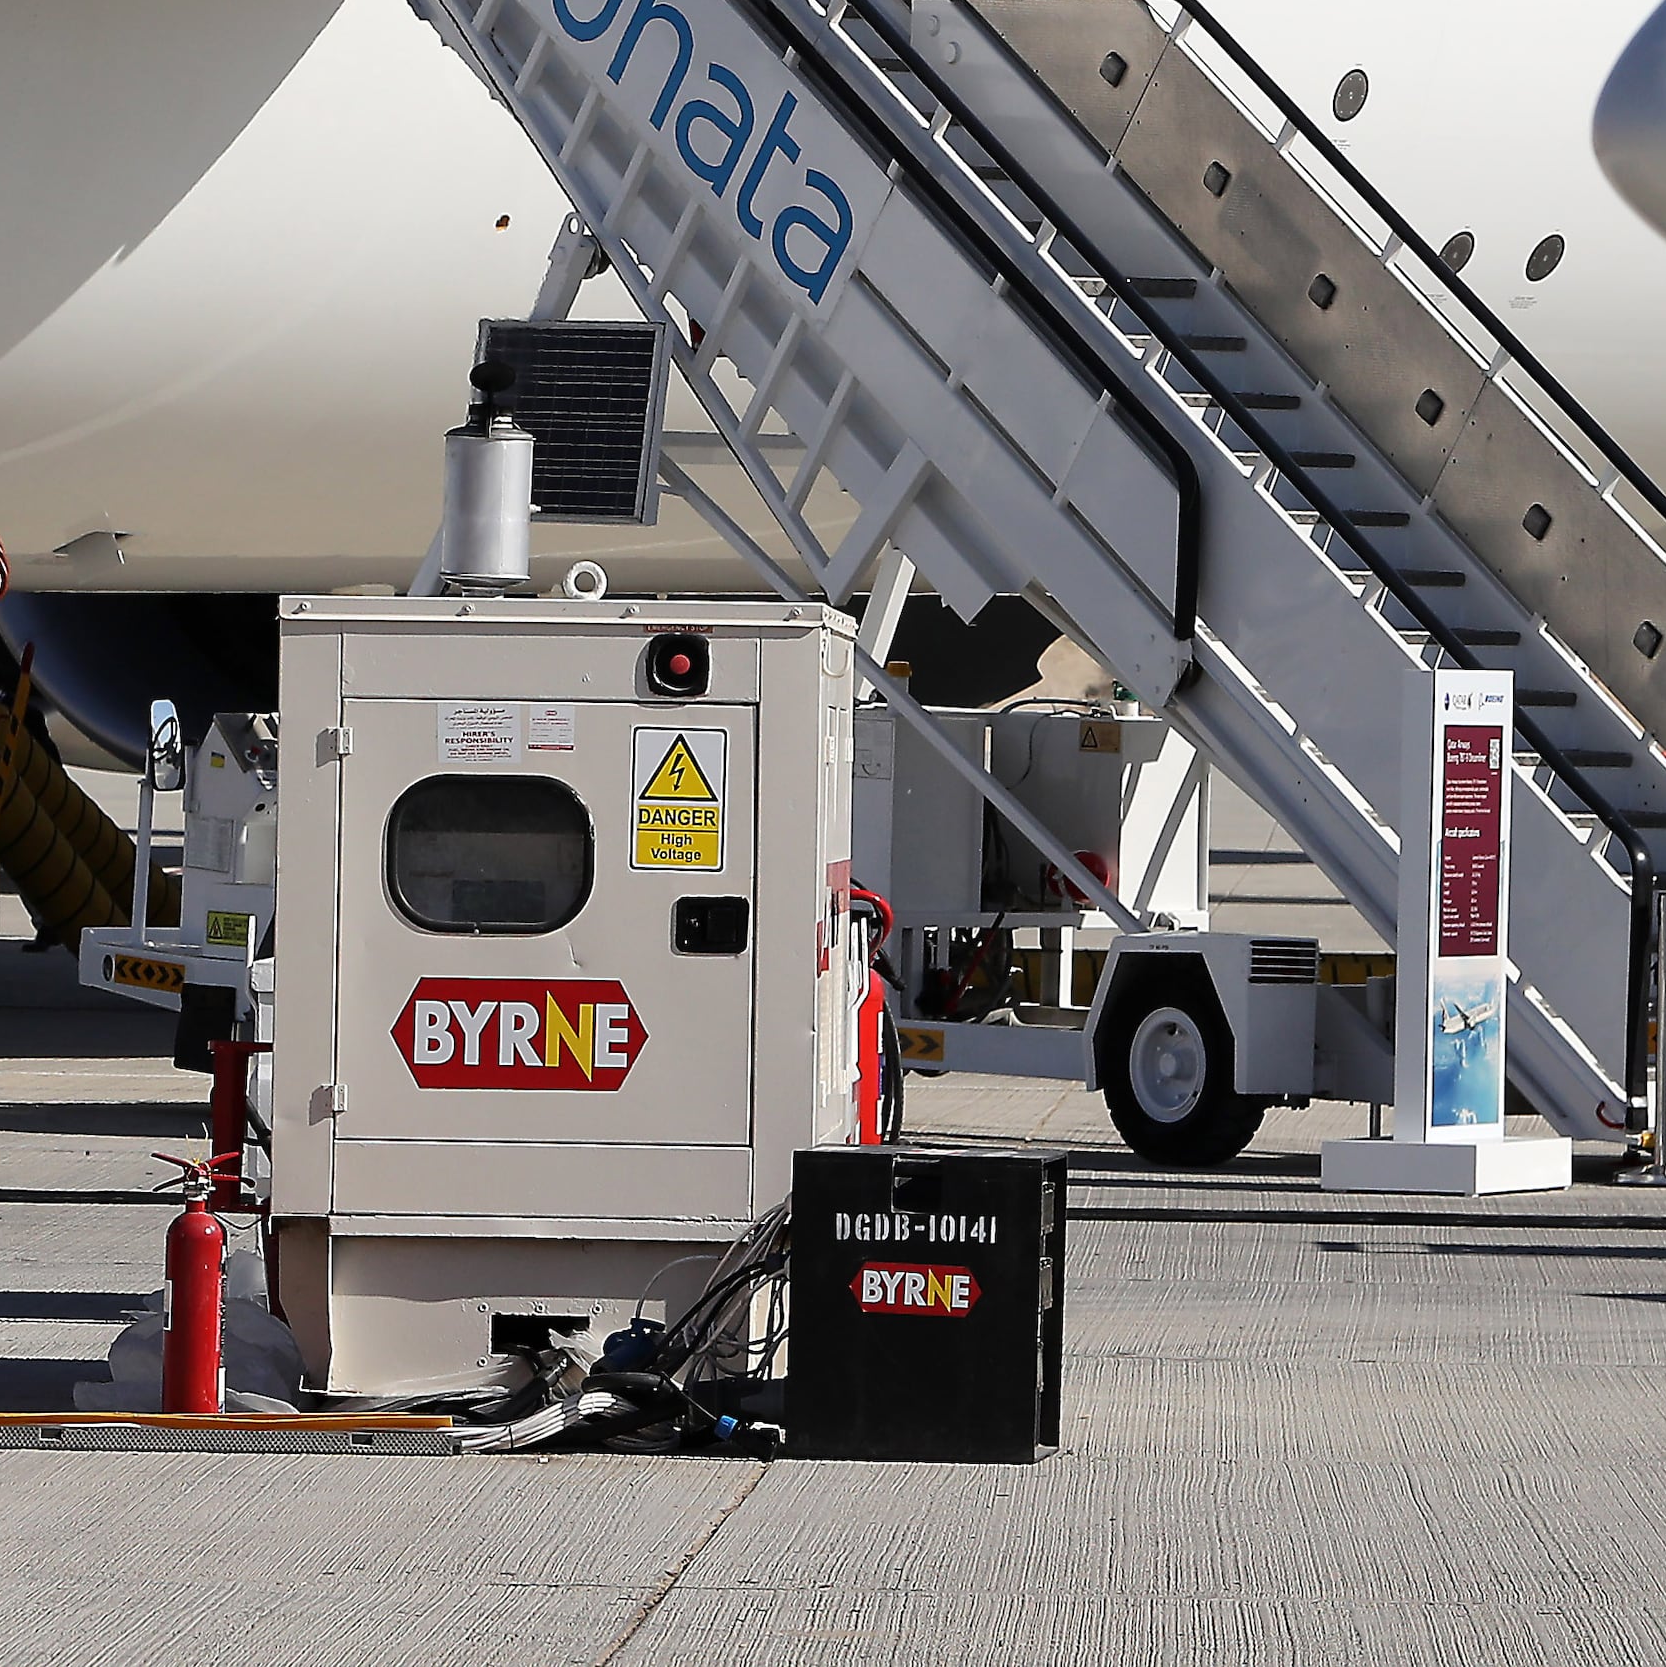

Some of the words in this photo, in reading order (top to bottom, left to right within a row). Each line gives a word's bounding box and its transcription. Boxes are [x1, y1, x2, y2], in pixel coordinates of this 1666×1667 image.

[638, 808, 717, 827] DANGER
[661, 833, 693, 848] High
[651, 847, 702, 862] Voltage
[413, 989, 630, 1083] BYRNE
[835, 1213, 997, 1244] DGDB-10141
[861, 1268, 970, 1313] BYRNE
